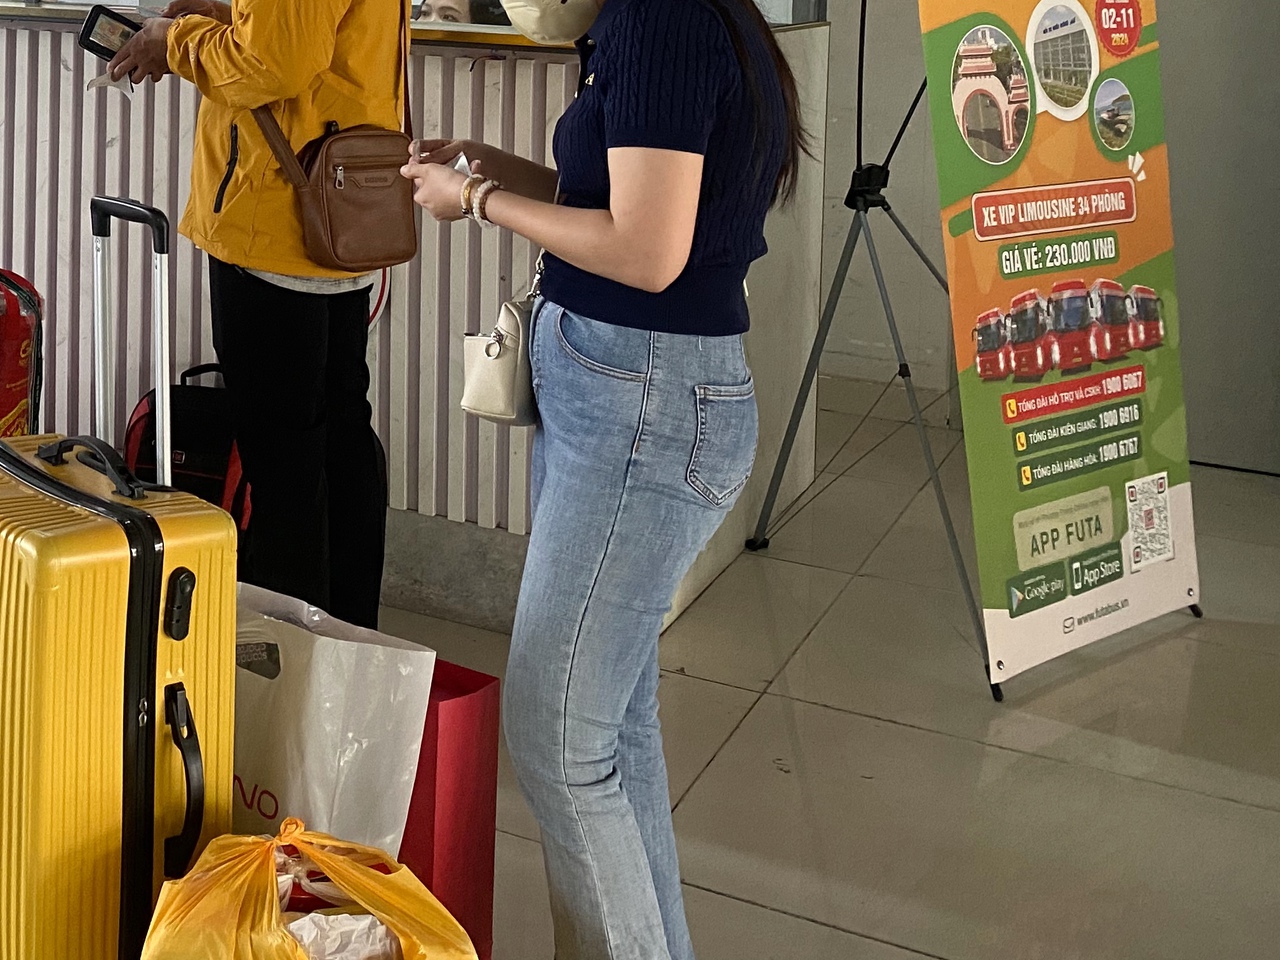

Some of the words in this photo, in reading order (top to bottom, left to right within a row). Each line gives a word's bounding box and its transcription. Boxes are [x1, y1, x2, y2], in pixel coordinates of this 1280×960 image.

[1101, 8, 1134, 29] 02-11
[982, 206, 997, 227] XE
[998, 203, 1016, 225] VIP
[1018, 196, 1076, 223] LIMOUSINE
[1078, 197, 1090, 214] 34
[1091, 190, 1125, 213] PHÒNG
[1002, 244, 1020, 274] GIÁ
[1023, 242, 1043, 269] VÉ:
[1045, 239, 1091, 268] 230.000
[1093, 237, 1116, 260] VNĐ
[1099, 410, 1118, 429] 1900
[1031, 528, 1060, 557] APP
[1065, 515, 1102, 545] FUTA
[1084, 565, 1100, 586] App
[1100, 560, 1120, 578] Store
[1024, 580, 1050, 600] Google
